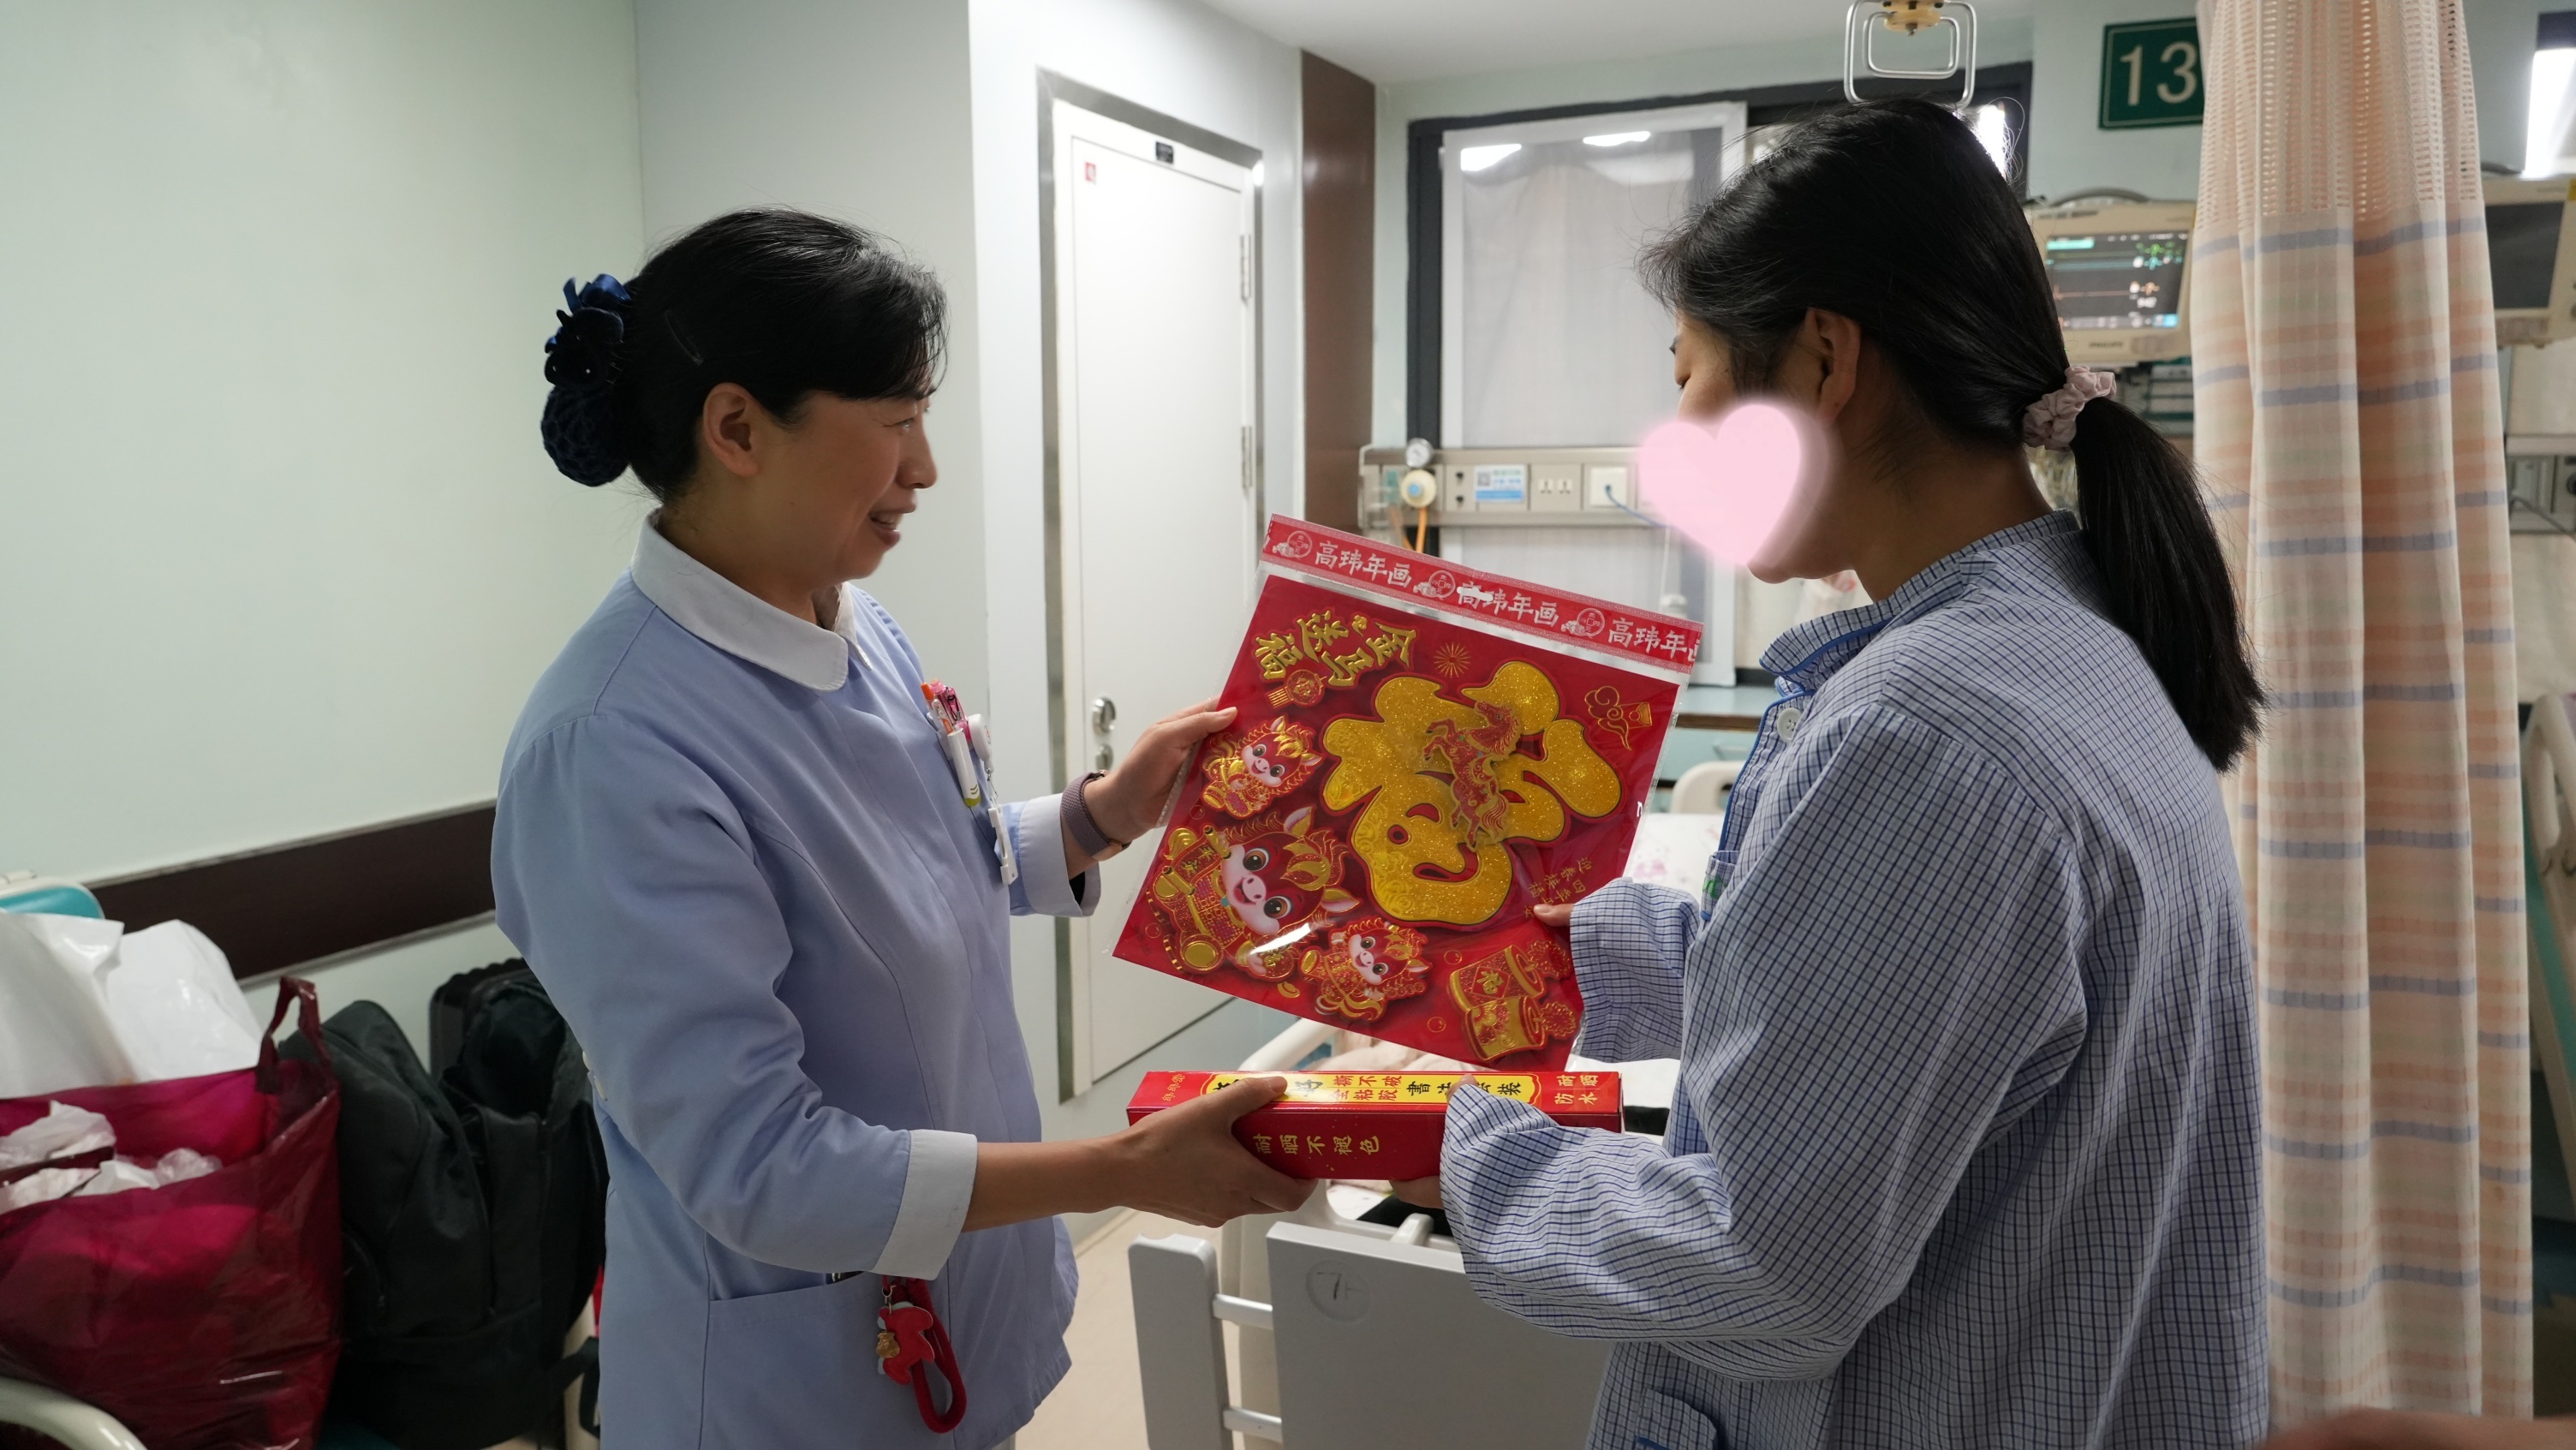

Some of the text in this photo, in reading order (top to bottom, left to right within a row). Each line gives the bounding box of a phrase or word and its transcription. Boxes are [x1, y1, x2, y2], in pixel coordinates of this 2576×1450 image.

[2120, 41, 2197, 106] 13
[1315, 540, 1411, 588] 高玮年画
[1252, 1132, 1380, 1156] 耐晒不褪色
